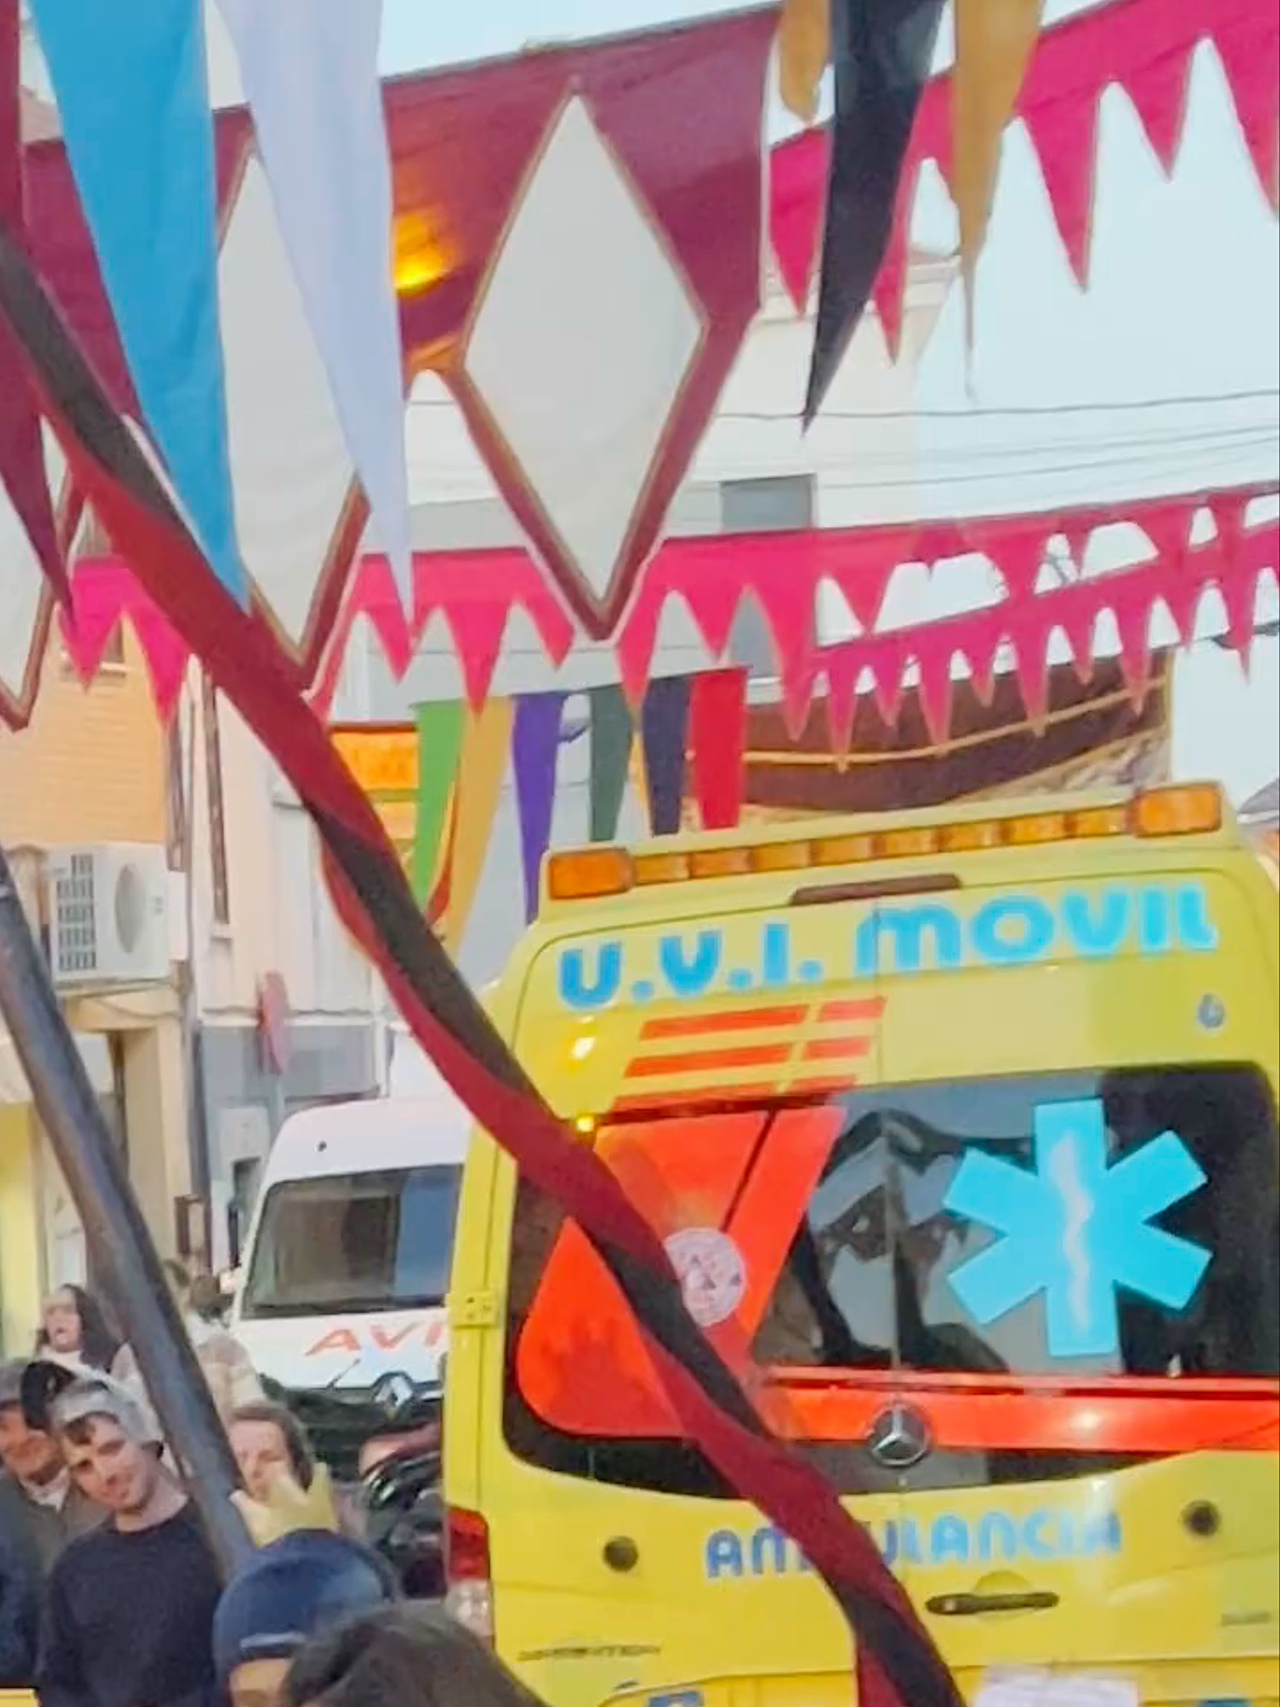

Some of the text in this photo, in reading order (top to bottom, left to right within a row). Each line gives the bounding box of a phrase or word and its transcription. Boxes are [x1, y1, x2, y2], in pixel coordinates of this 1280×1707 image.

[557, 879, 1220, 1009] U.V.I. MOVIL
[304, 1321, 444, 1355] AVI
[707, 1509, 1121, 1578] AMULANCIA
